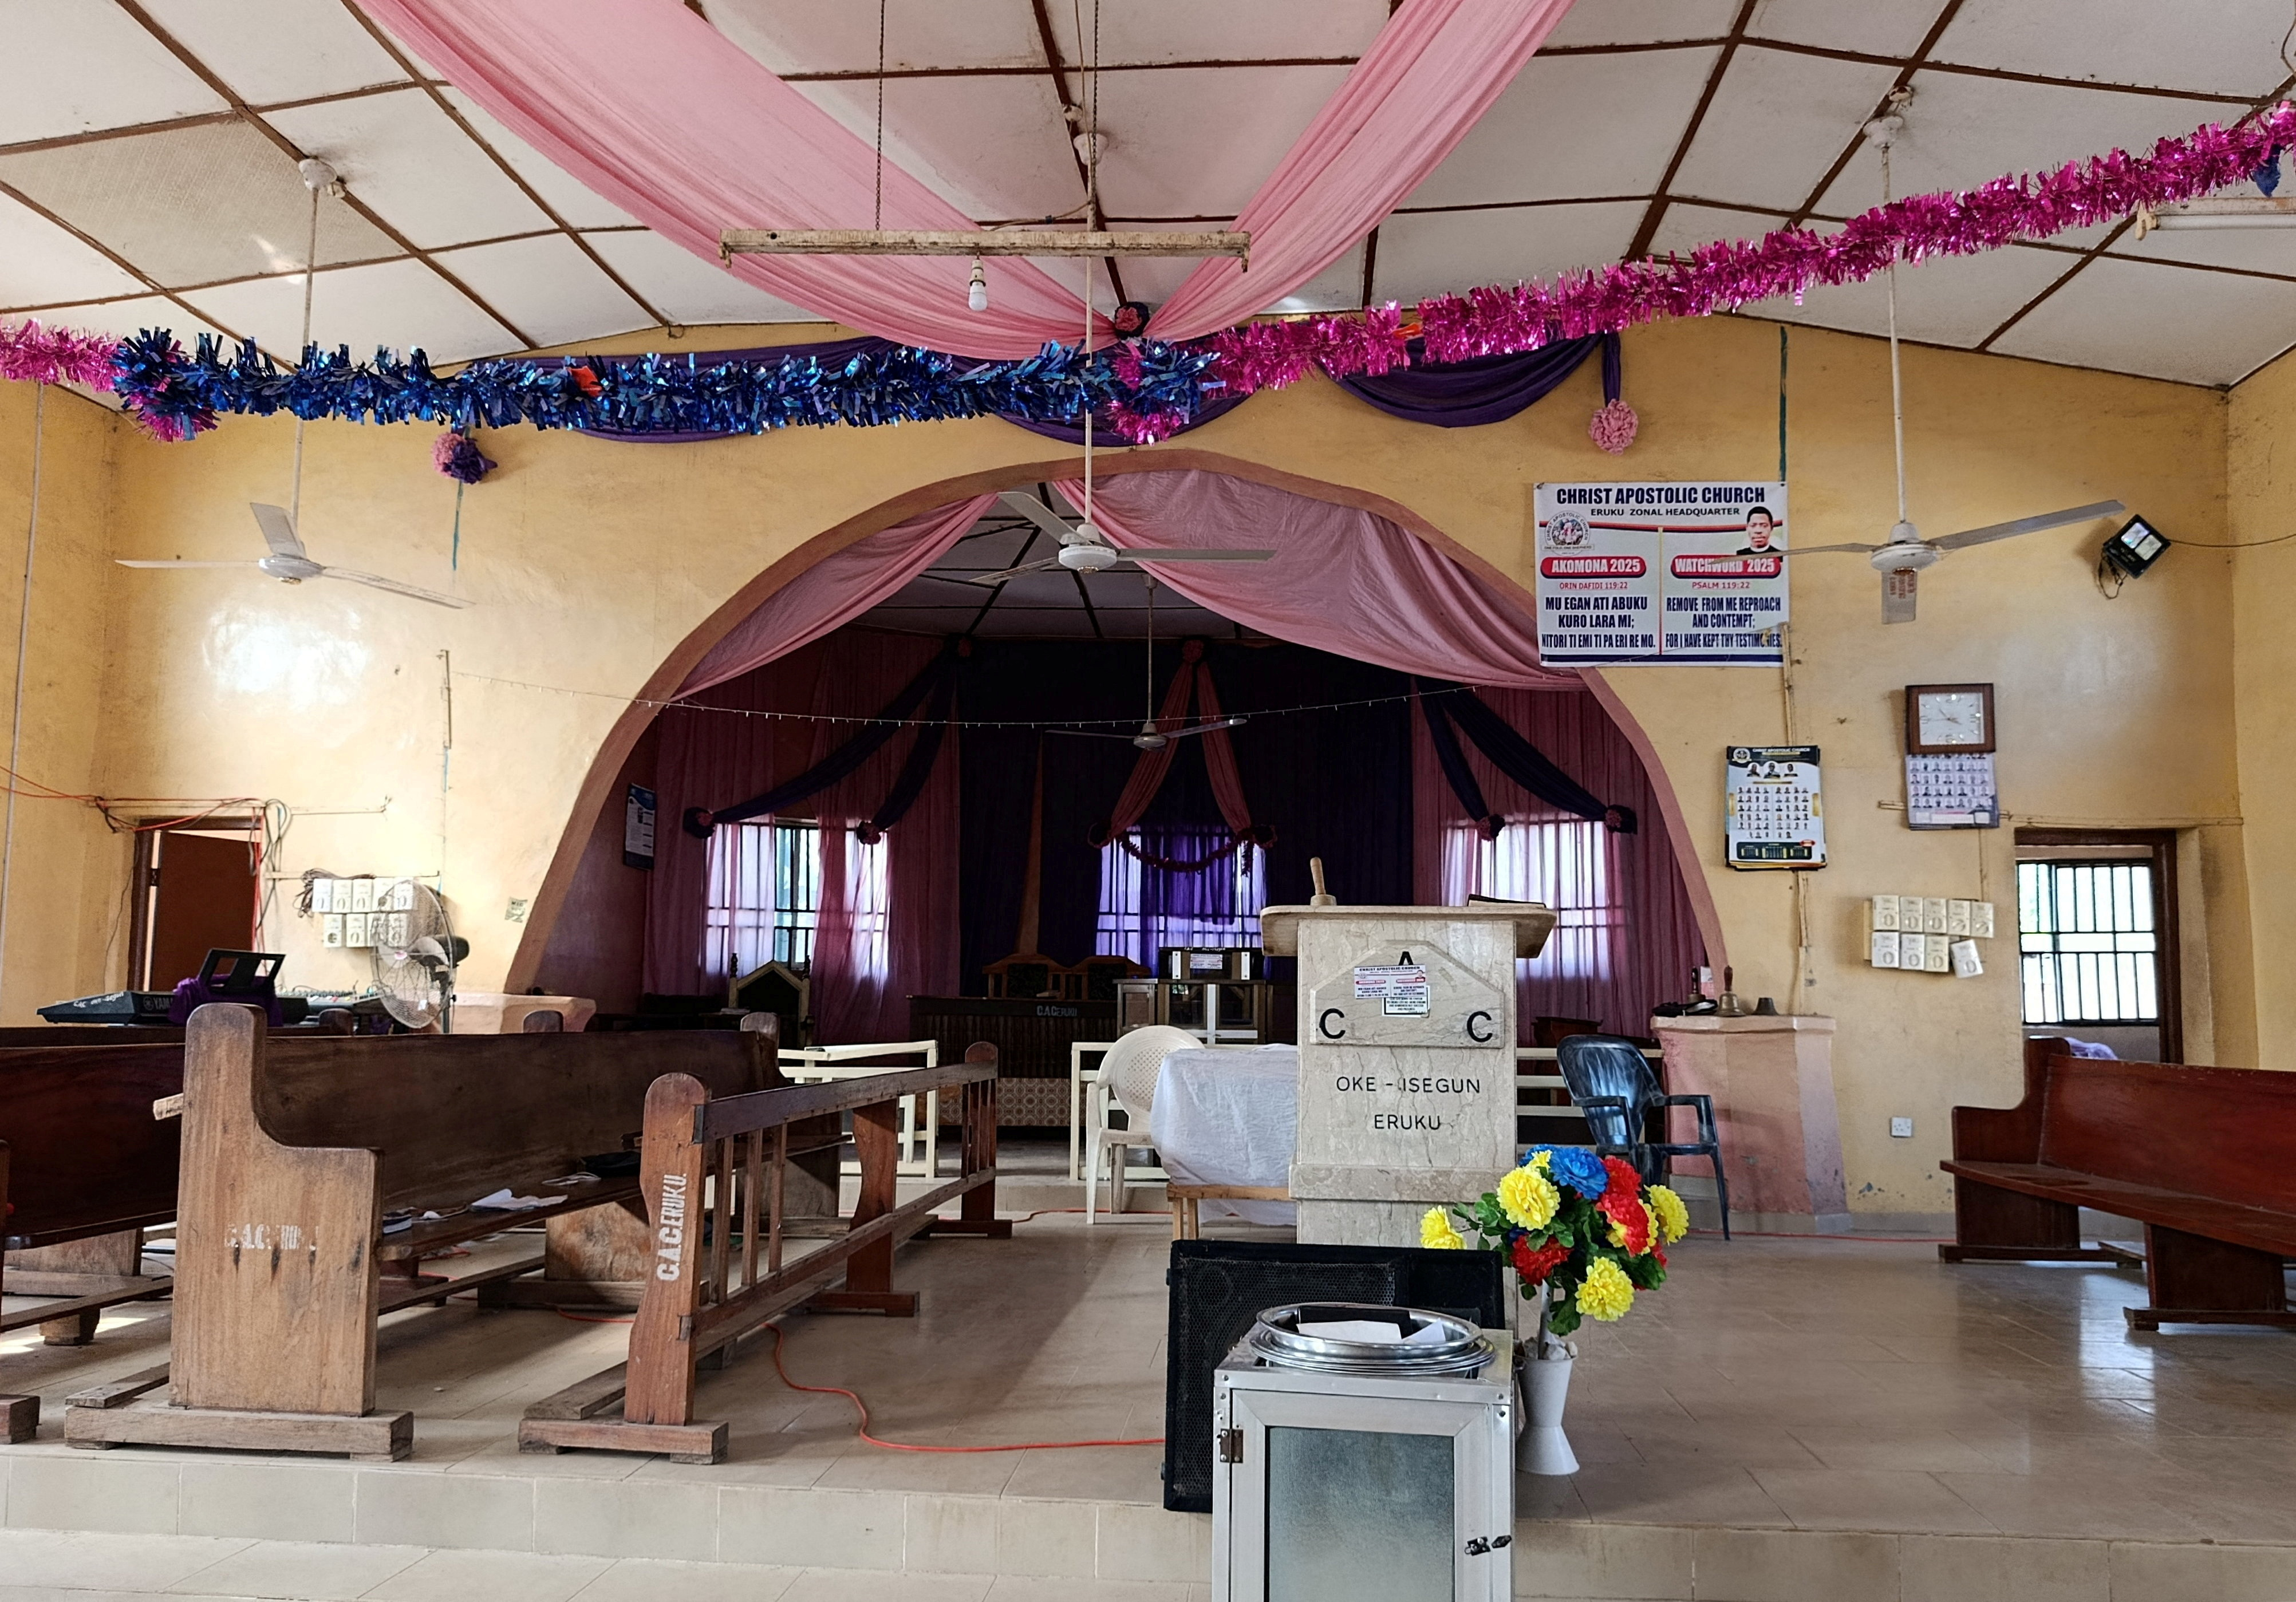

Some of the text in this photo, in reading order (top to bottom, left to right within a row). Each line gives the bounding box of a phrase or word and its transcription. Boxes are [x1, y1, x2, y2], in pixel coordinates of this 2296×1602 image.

[1556, 487, 1765, 504] CHRIST APOSTOLIC CHURCH
[1591, 508, 1624, 516] ERUKU
[1666, 507, 1740, 516] HEADQUARTER
[1552, 558, 1640, 573] AKOMONA 2025
[1675, 558, 1775, 573] WATCHWORD 2025
[1579, 582, 1603, 590] DAFIDI
[1545, 597, 1647, 610] MU EGAN ATI ABUKU
[1666, 597, 1781, 611] REMOVE FROM ME REPROACH
[1559, 614, 1634, 629] KURO LARA MI;
[1693, 613, 1755, 629] AND CONTEMPT;
[1542, 634, 1656, 648] NITORI TI EMI TI PA ERI RE MO.
[1666, 633, 1678, 648] FOR
[1680, 633, 1683, 648] I
[1684, 633, 1702, 648] HAVE
[1703, 633, 1719, 648] KEPT
[1721, 633, 1736, 648] THY
[1398, 952, 1414, 965] A
[152, 997, 173, 1010] YAM
[1319, 1008, 1493, 1043] C C
[1336, 1076, 1376, 1092] OKE
[1402, 1078, 1480, 1094] ISEGUN
[1374, 1114, 1441, 1130] ERUKU
